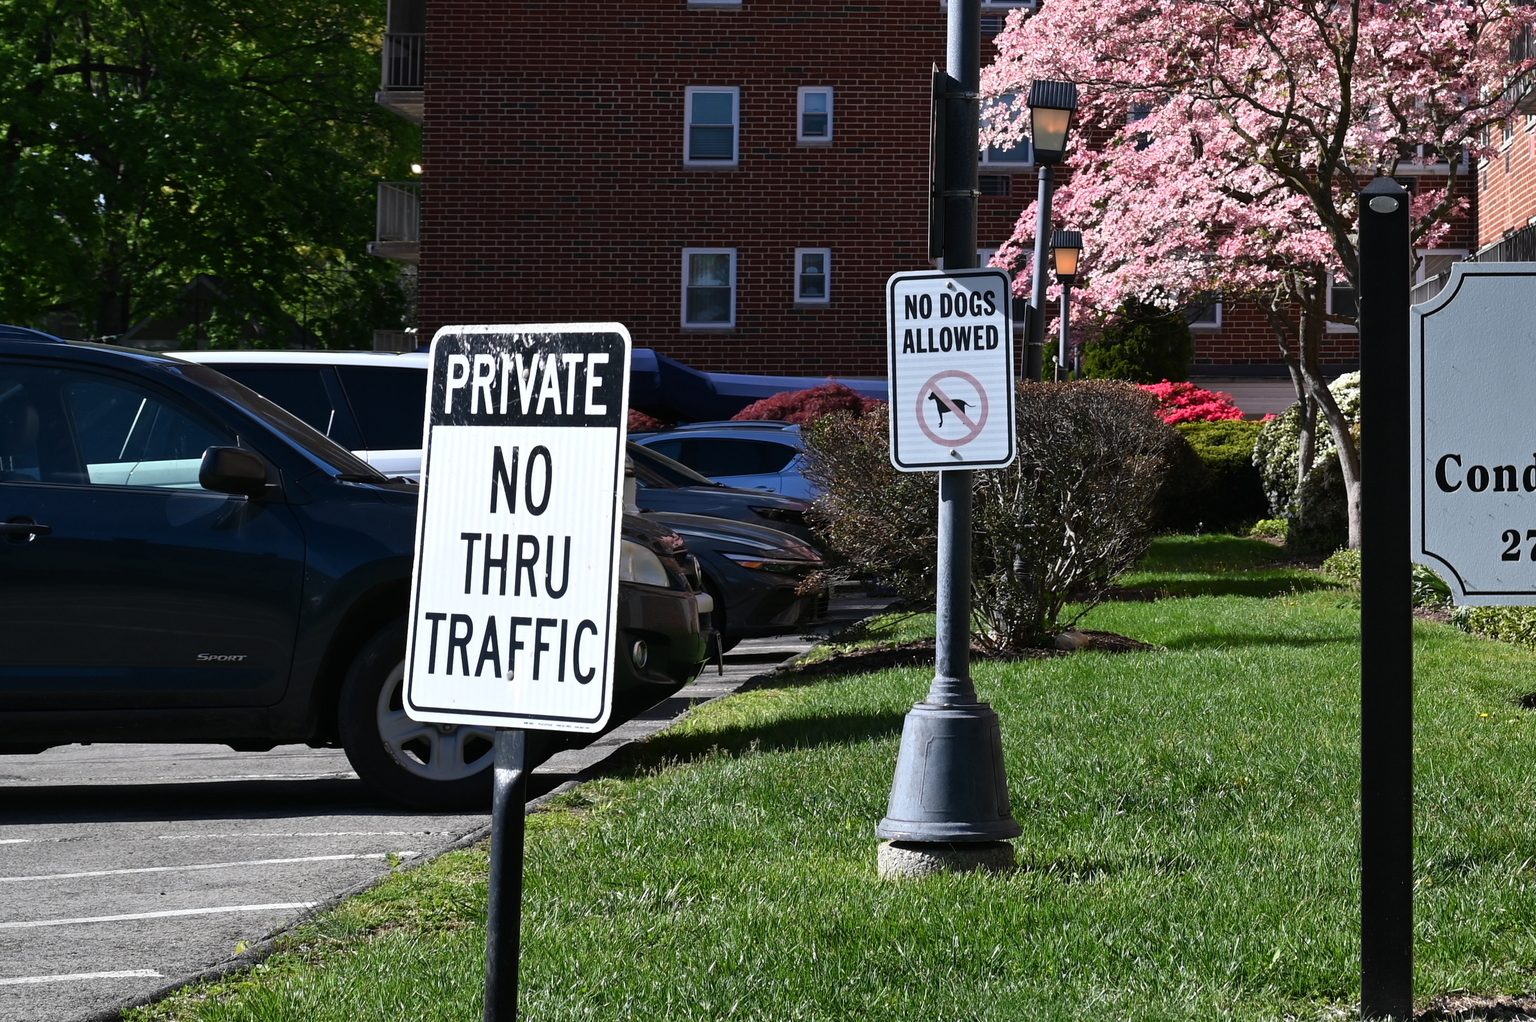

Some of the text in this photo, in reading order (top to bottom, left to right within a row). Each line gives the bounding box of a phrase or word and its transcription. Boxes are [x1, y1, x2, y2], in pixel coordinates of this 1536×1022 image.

[904, 289, 997, 321] NO DOGS
[902, 324, 1000, 355] ALLOWED
[444, 352, 610, 416] PRIVATE
[489, 444, 554, 517] NO
[460, 531, 573, 601] THRU
[424, 611, 599, 686] TRAFFIC
